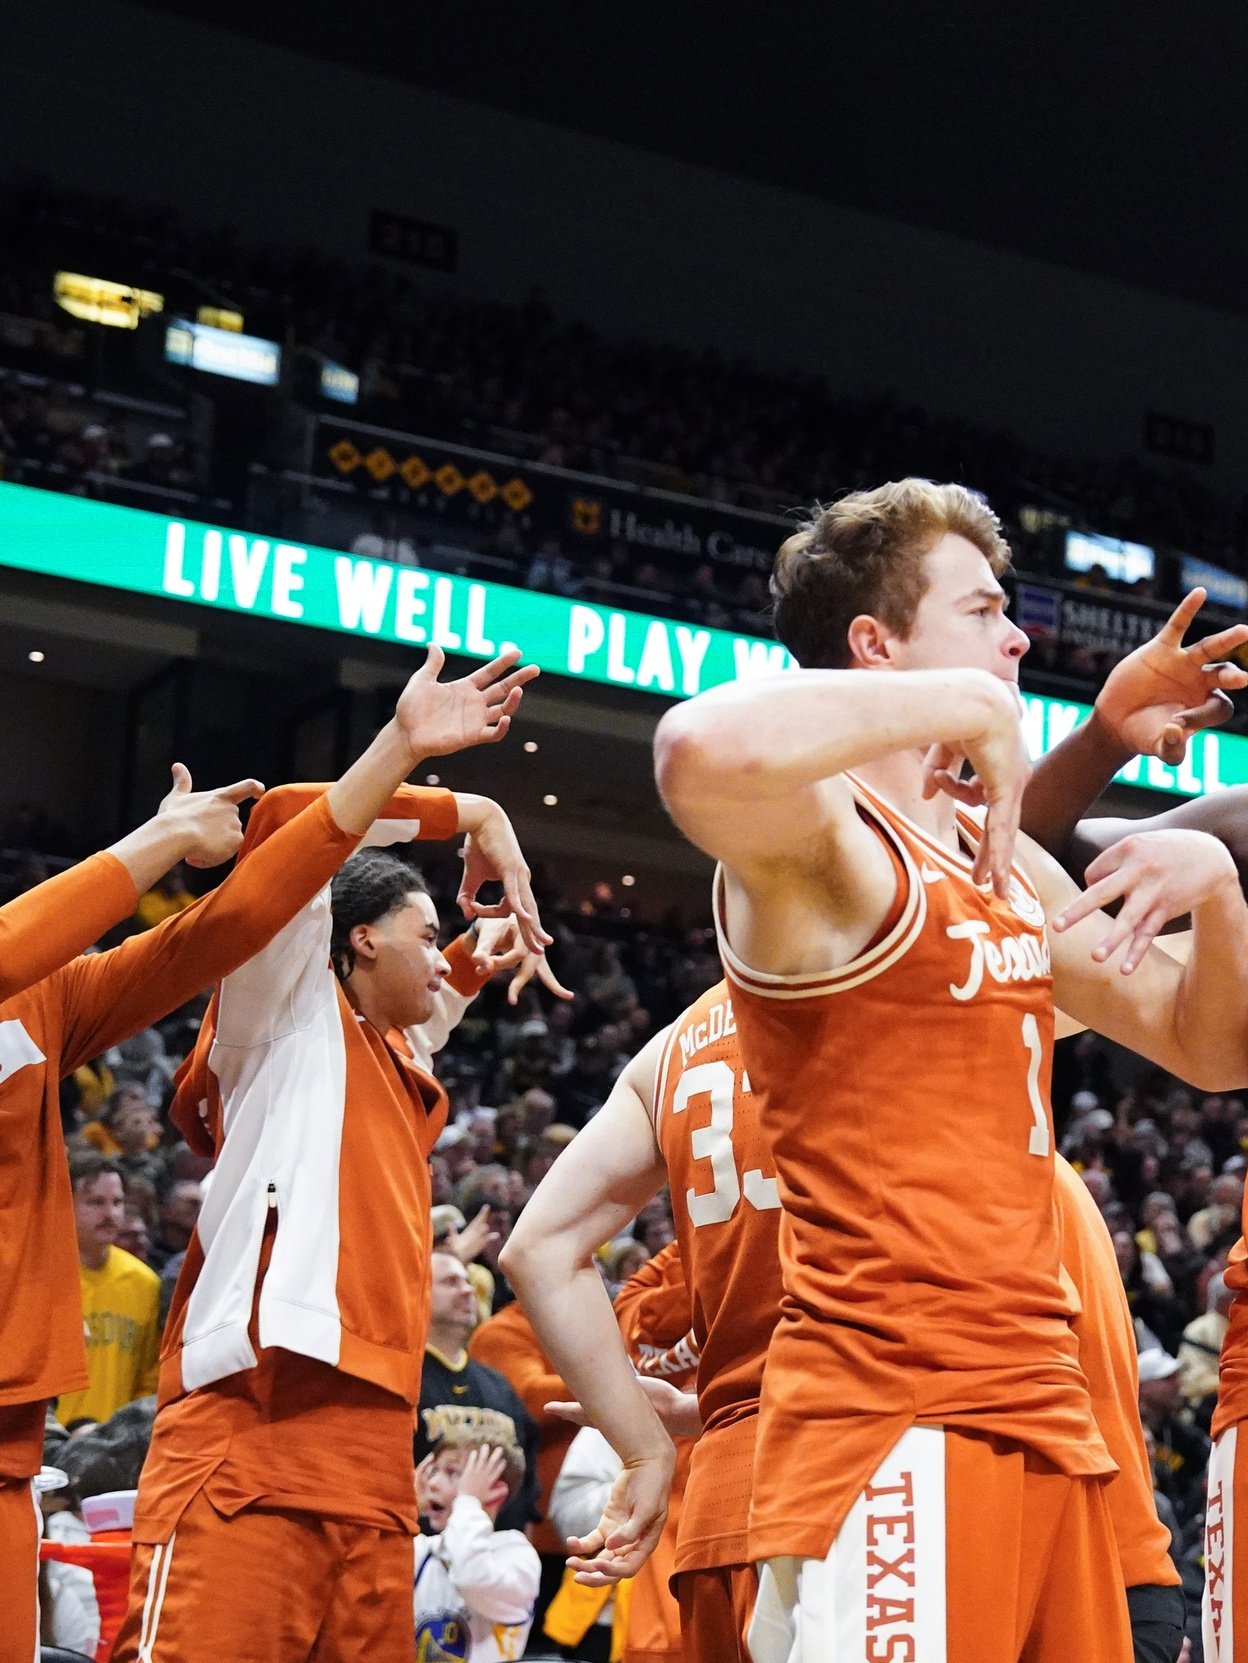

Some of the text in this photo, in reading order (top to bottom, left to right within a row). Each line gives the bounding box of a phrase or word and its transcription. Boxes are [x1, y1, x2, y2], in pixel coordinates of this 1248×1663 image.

[163, 521, 308, 619] LIVE
[567, 604, 711, 696] PLAY
[1114, 733, 1228, 794] ELL
[1021, 1012, 1050, 1158] 1
[865, 1471, 915, 1663] TEXAS
